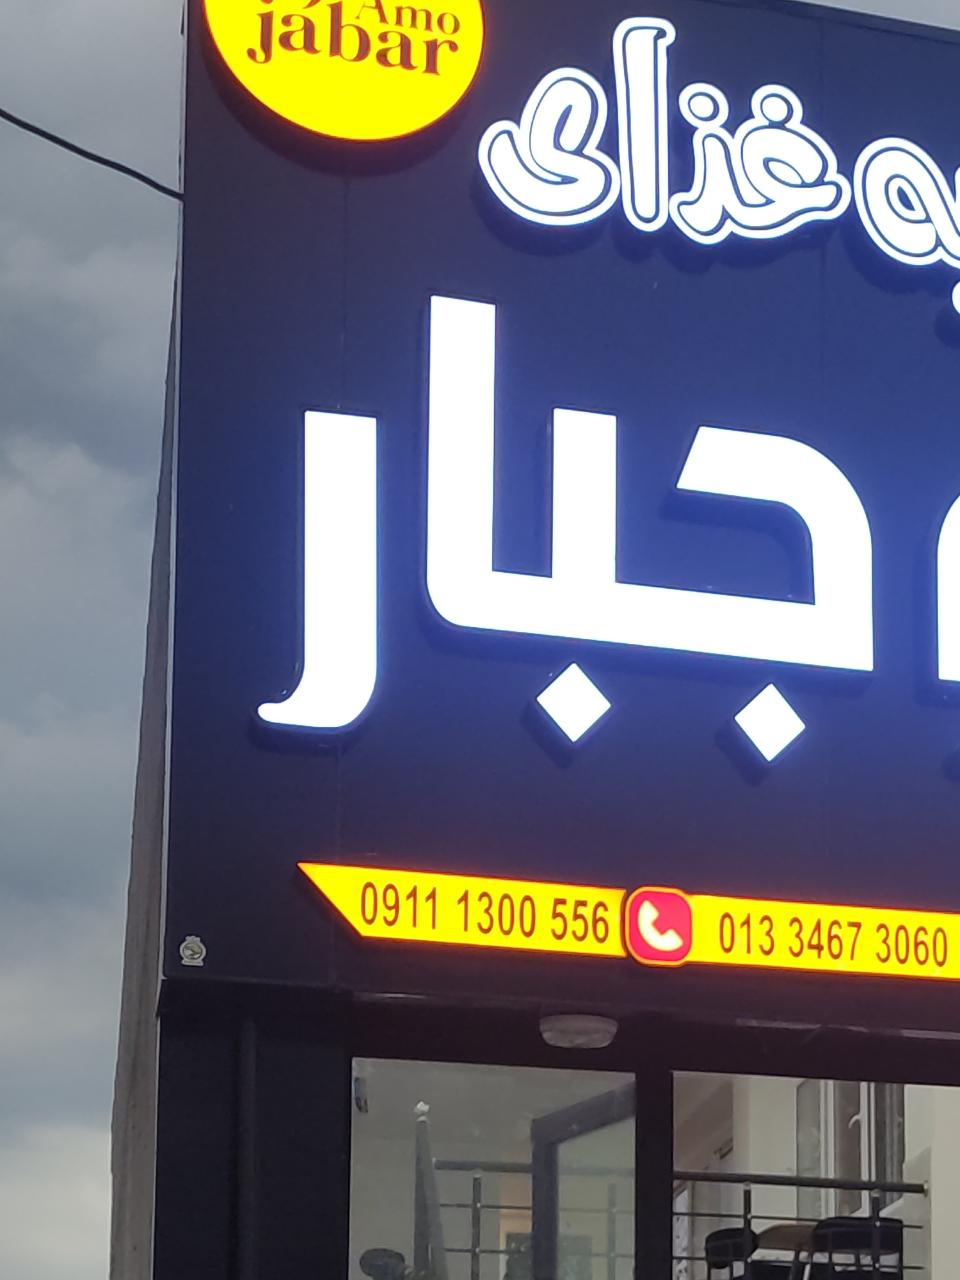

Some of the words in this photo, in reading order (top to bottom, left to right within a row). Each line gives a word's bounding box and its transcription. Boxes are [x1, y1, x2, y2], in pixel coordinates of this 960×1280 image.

[354, 0, 461, 35] Amo
[360, 881, 437, 930] 0911
[456, 888, 537, 938] 1300
[550, 896, 610, 944] 556
[719, 912, 776, 956] 013
[788, 916, 863, 961] 3467
[875, 923, 949, 968] 3060
